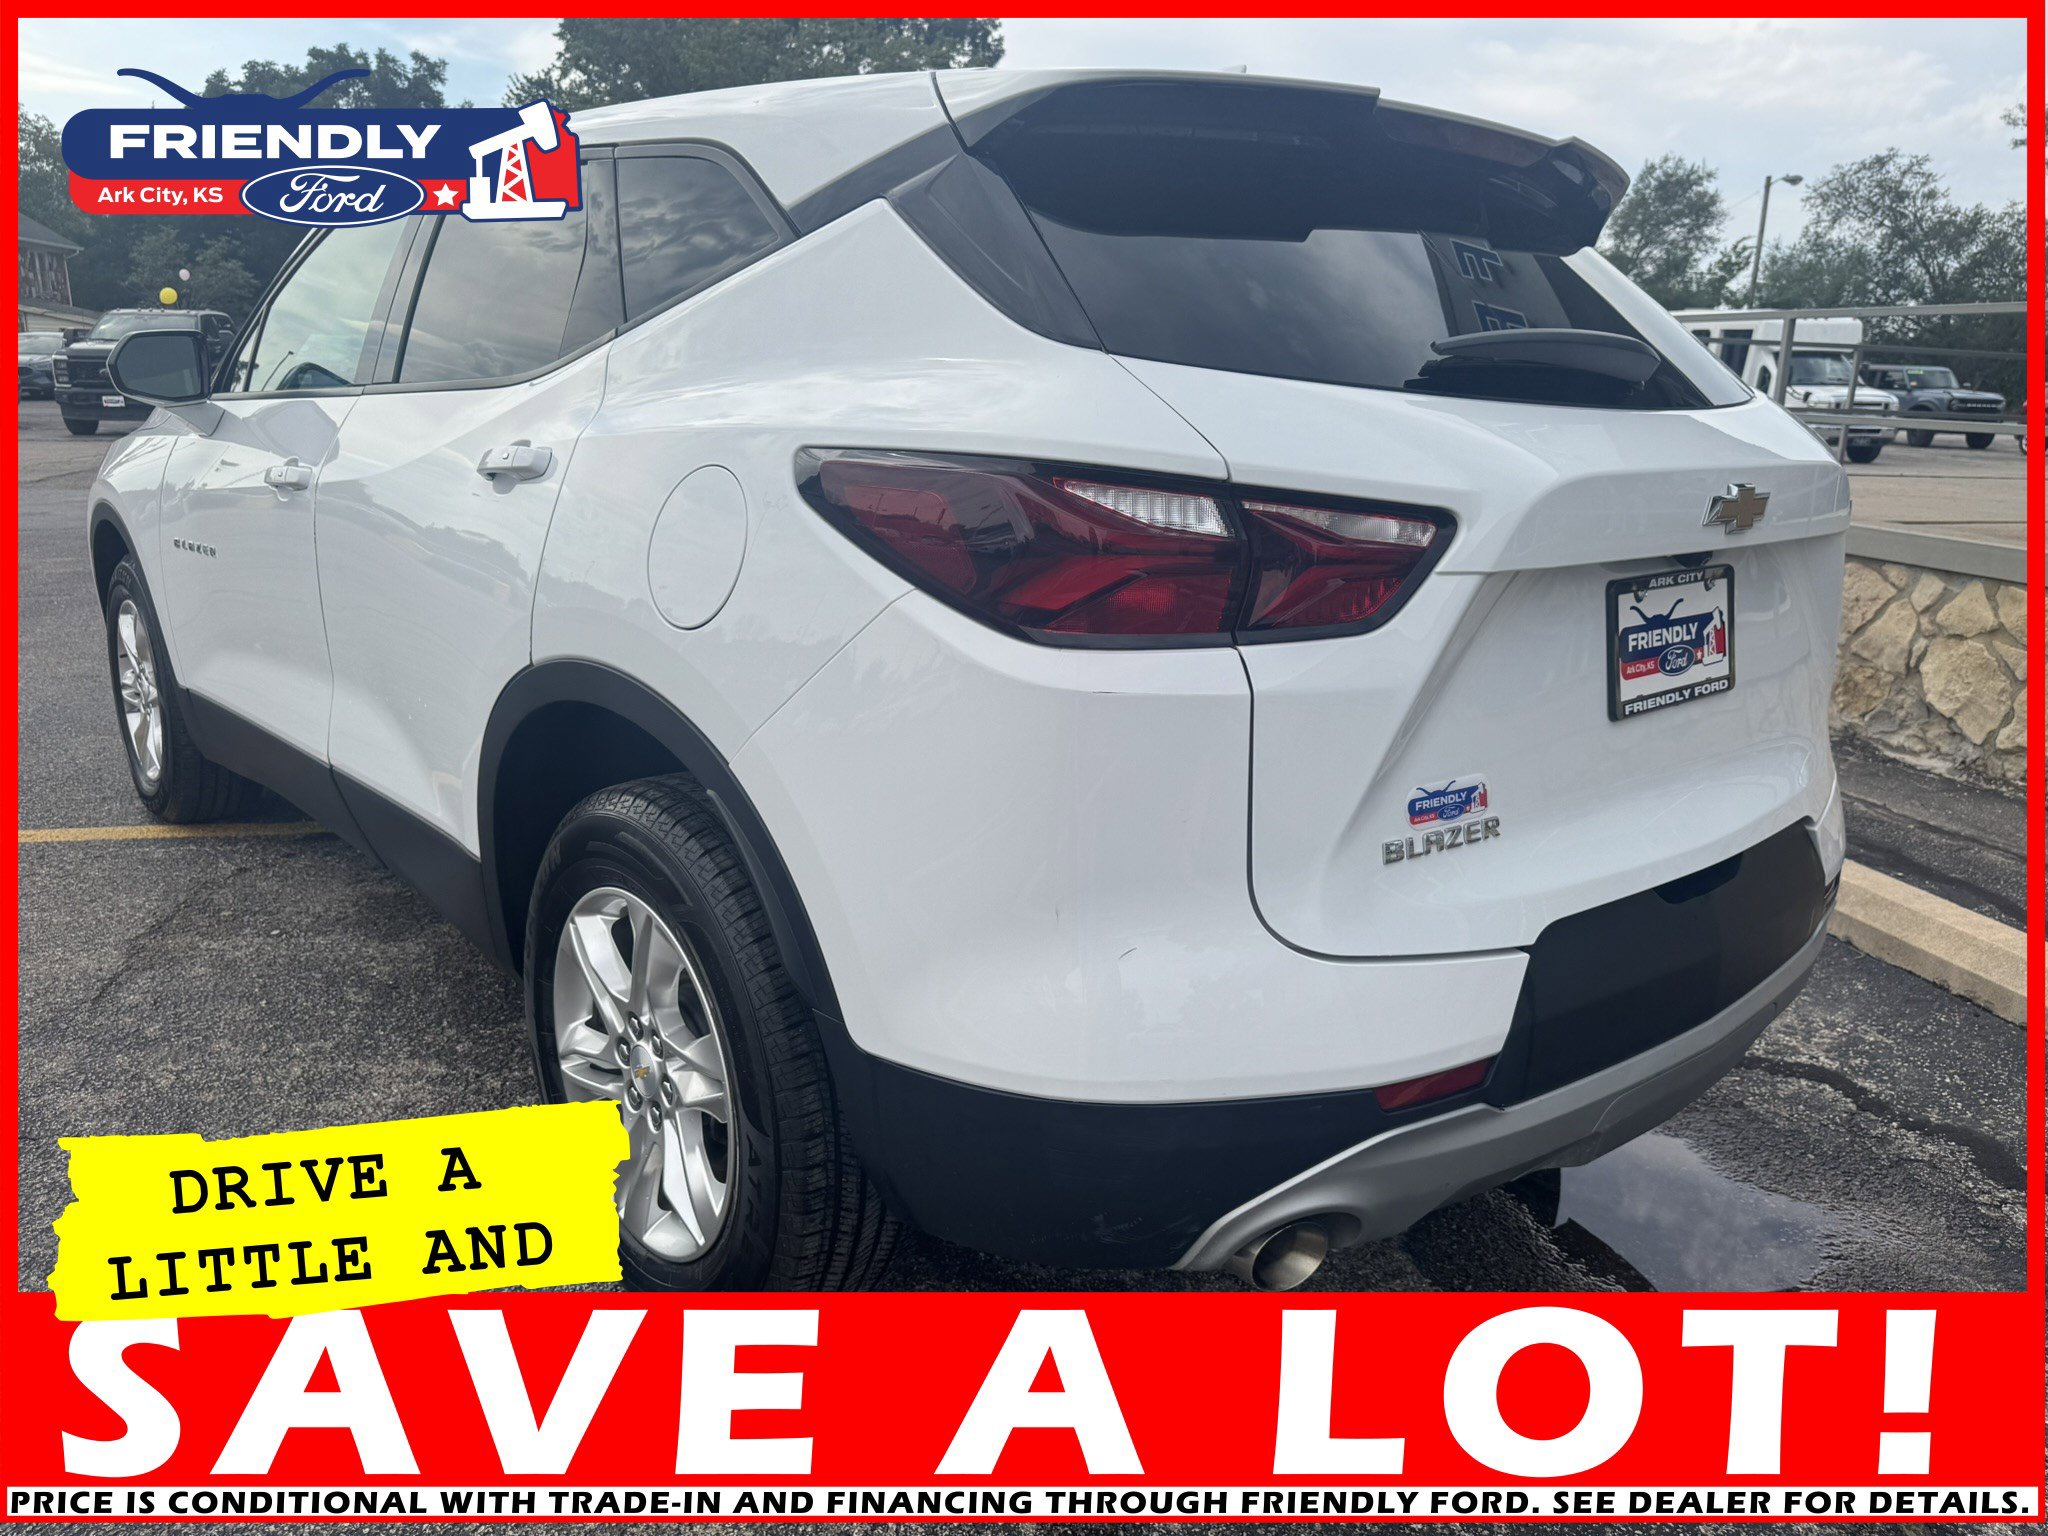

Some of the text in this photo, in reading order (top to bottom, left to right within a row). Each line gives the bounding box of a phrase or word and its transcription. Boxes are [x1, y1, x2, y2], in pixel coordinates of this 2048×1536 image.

[1649, 571, 1703, 588] ARK CITY
[1628, 622, 1699, 652] FRIENDLY
[1665, 650, 1688, 670] Ford
[1625, 679, 1729, 715] FRIENDLY FORD
[1415, 791, 1467, 811] FRIENDLY
[1382, 815, 1500, 865] BLAZER
